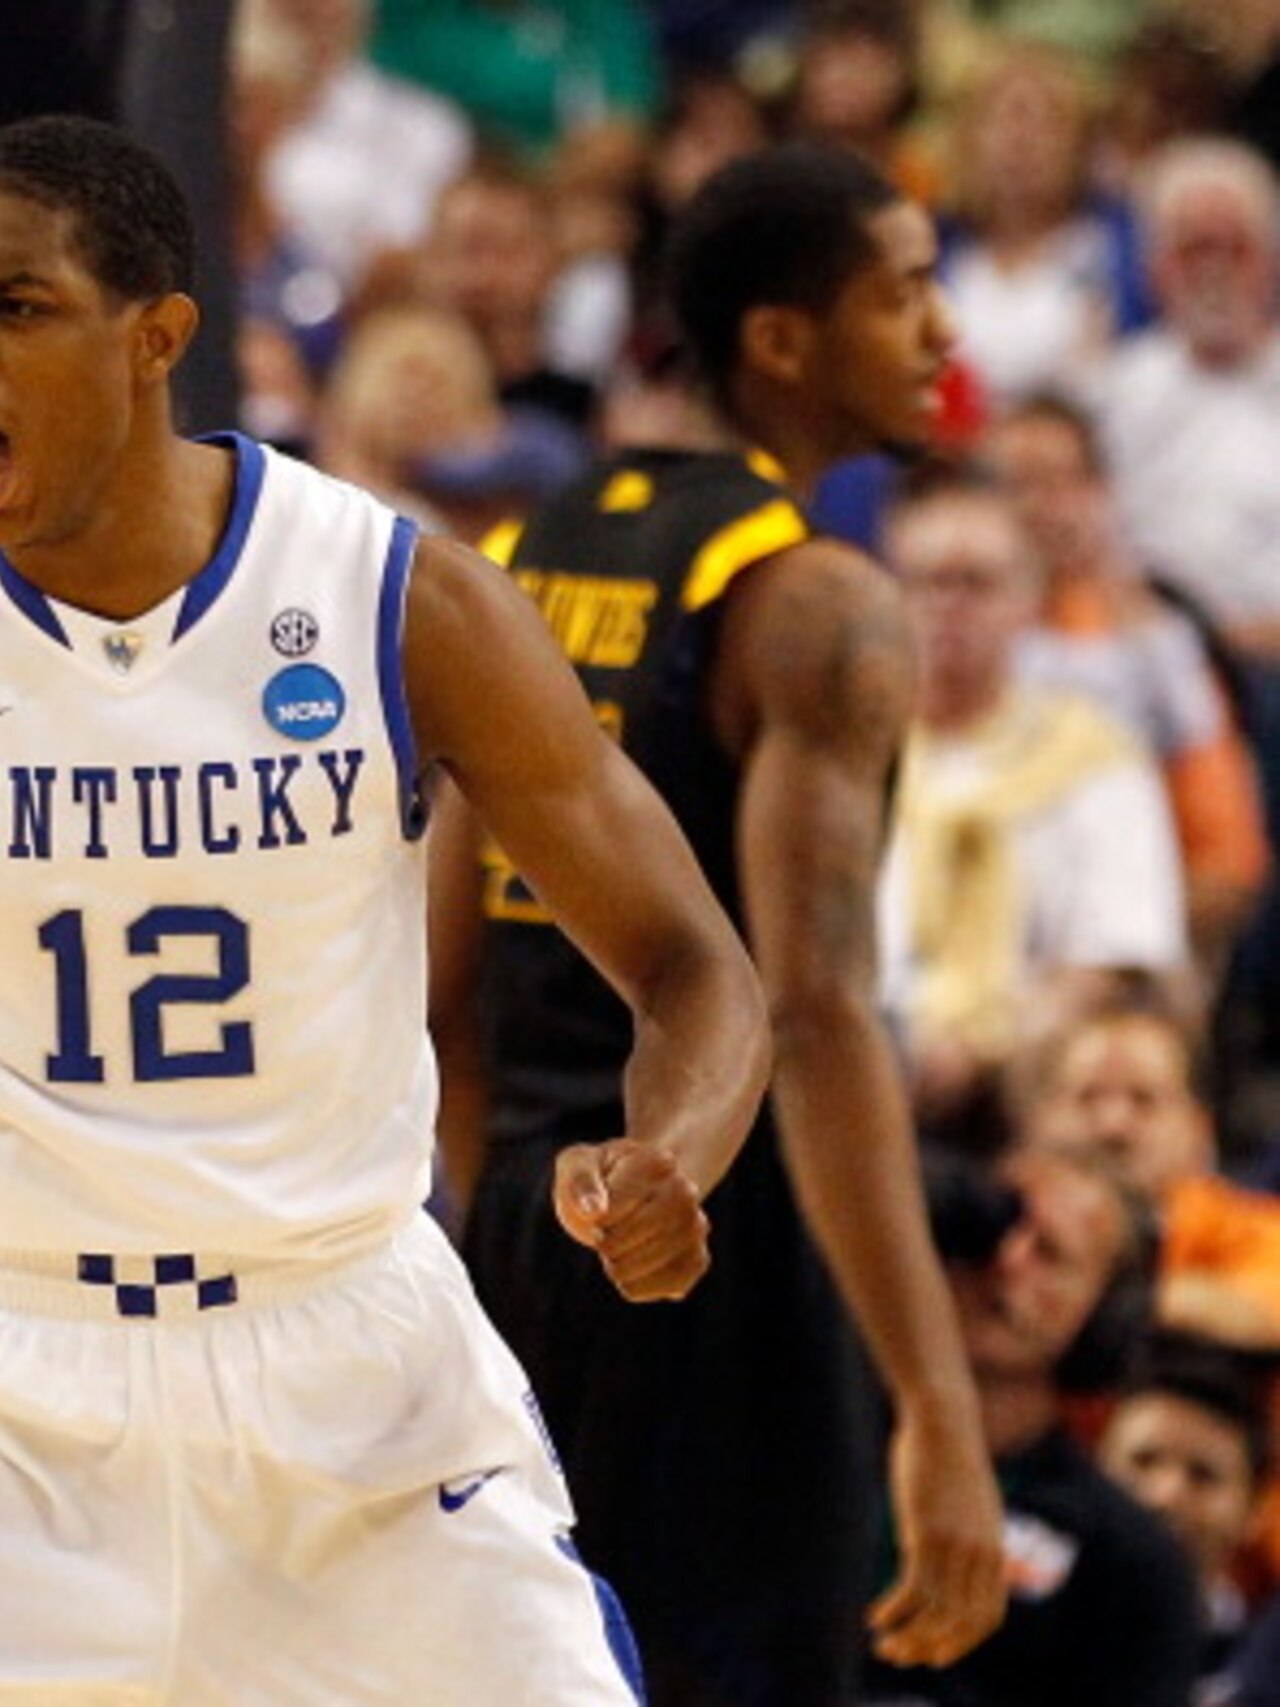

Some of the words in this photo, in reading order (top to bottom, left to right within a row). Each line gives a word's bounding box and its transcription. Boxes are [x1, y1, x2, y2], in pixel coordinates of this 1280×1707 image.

[273, 609, 317, 654] SEC
[276, 701, 337, 722] NCAA
[38, 905, 255, 1082] 12
